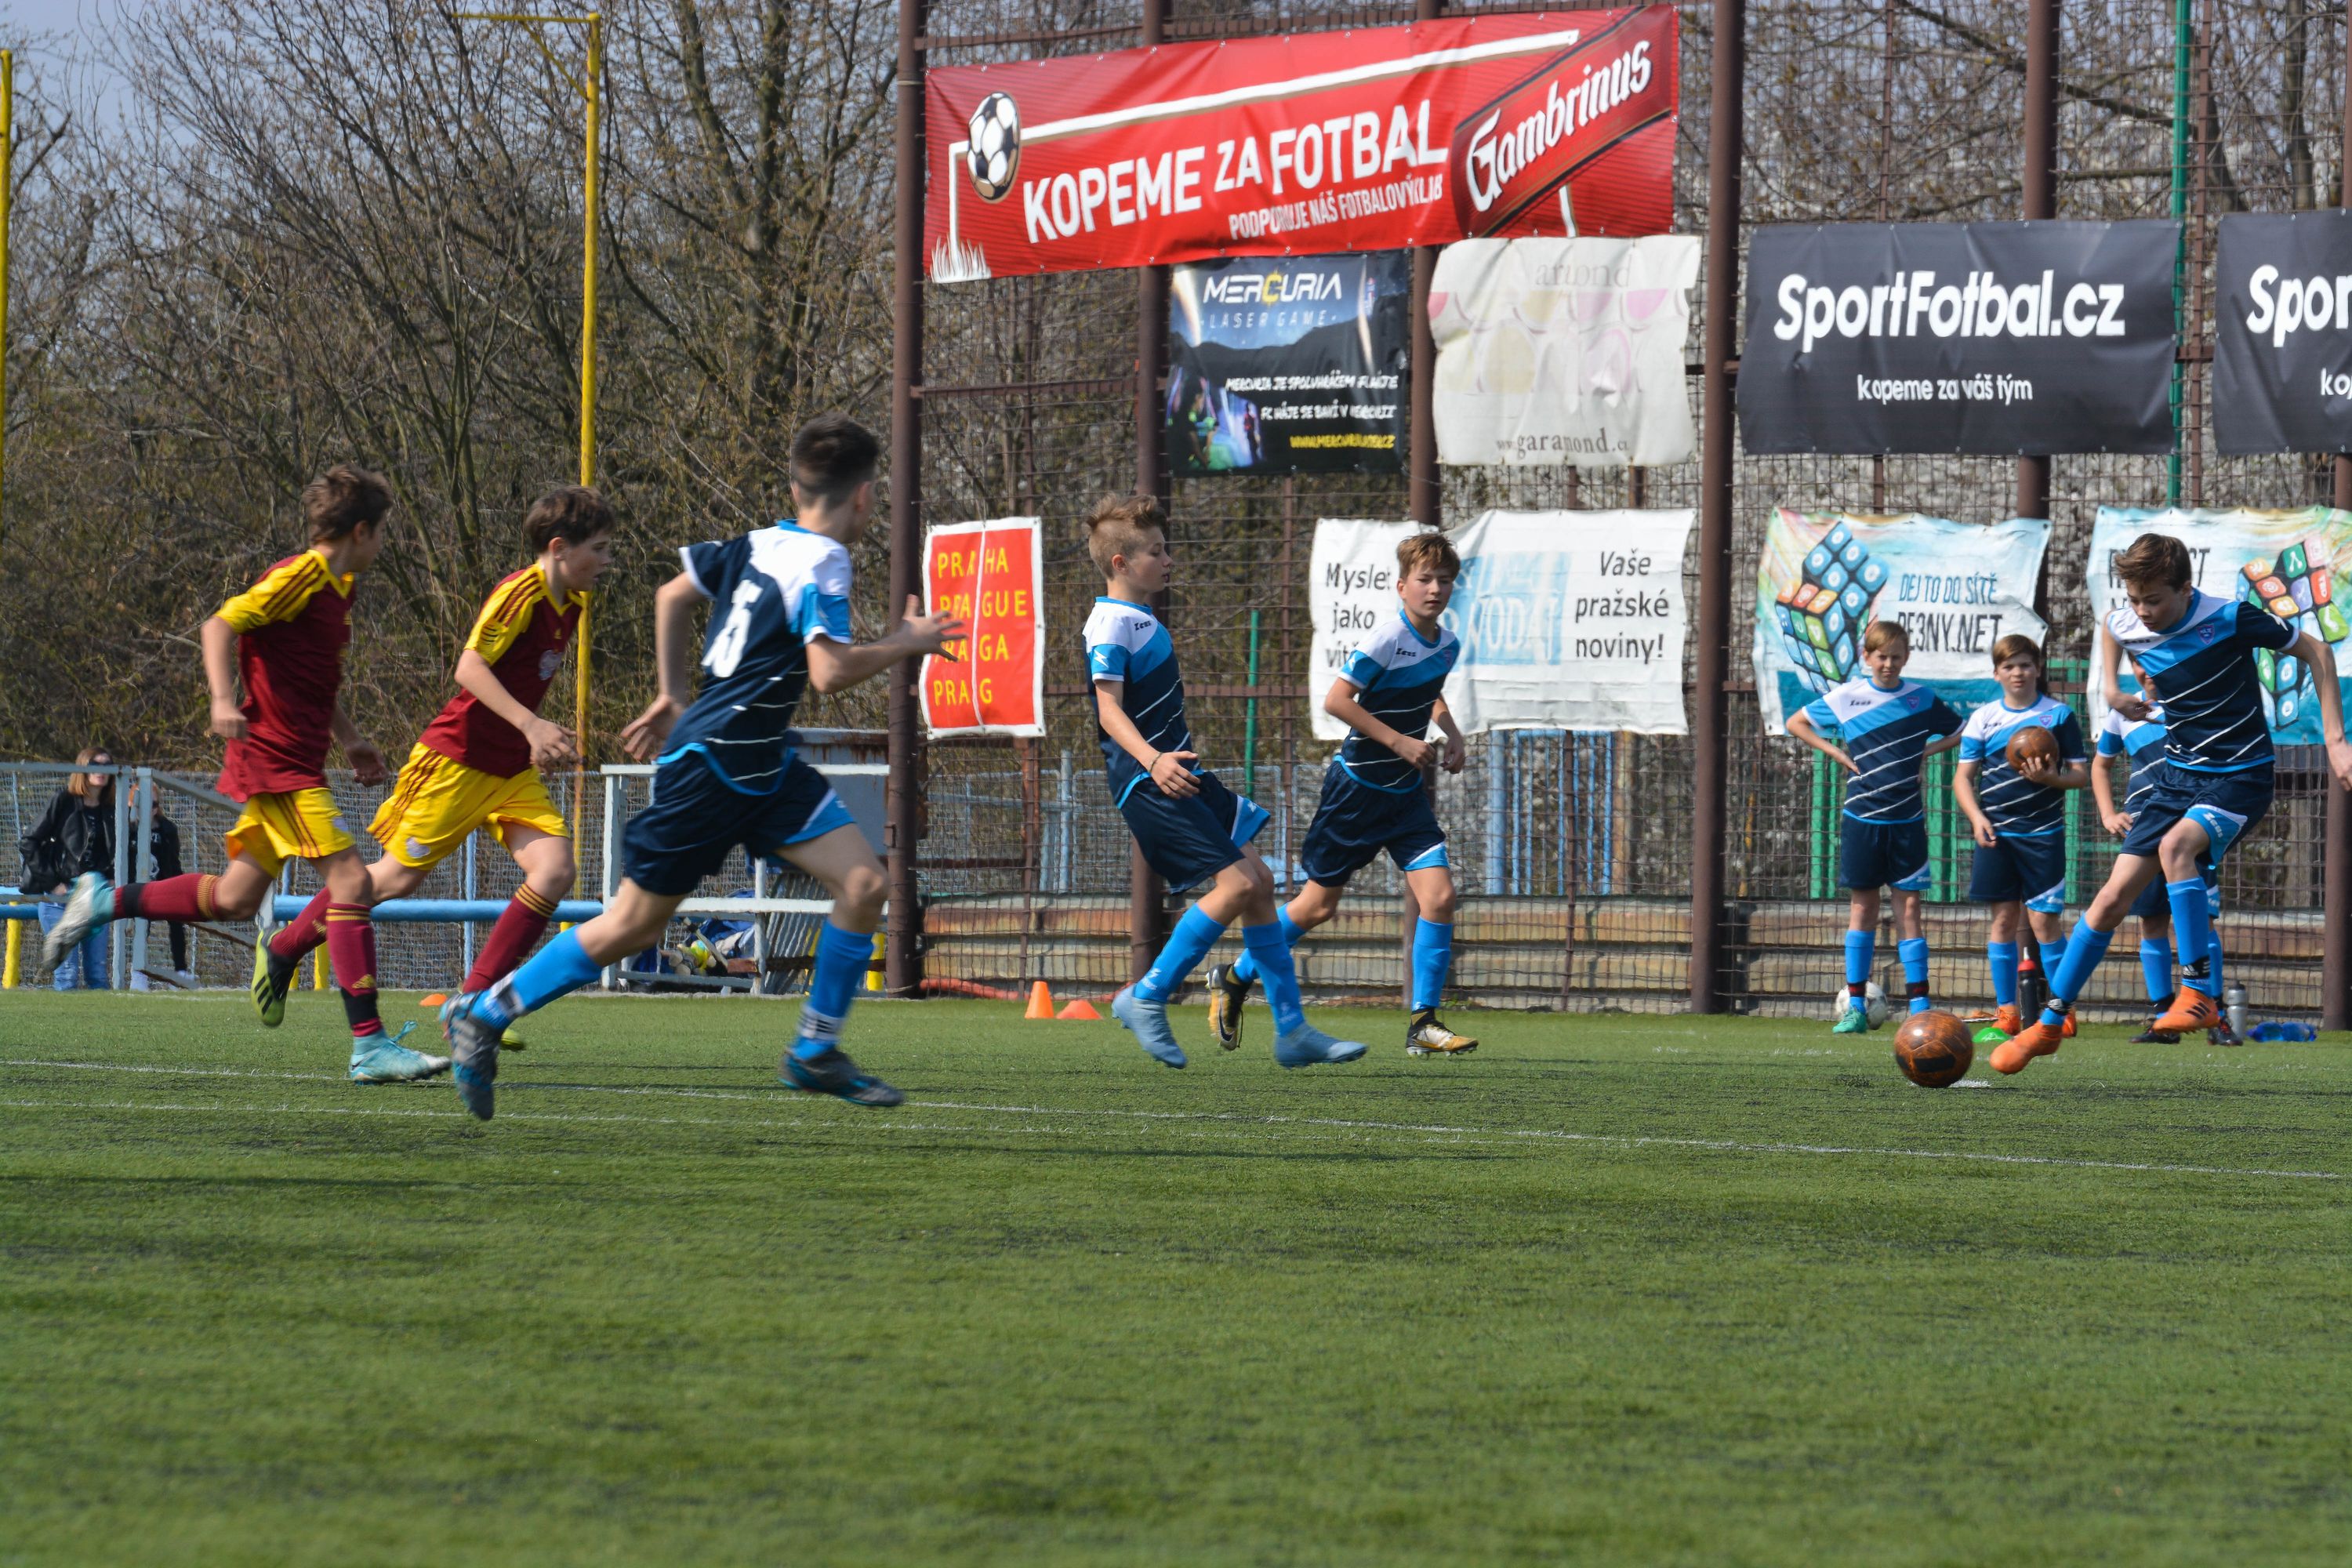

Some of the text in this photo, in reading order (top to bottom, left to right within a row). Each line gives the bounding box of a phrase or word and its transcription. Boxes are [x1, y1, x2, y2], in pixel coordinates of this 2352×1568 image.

[1466, 41, 1652, 212] Gambrinus
[1023, 146, 1206, 243] KOPEME
[1215, 136, 1264, 193] ZA
[1272, 99, 1448, 195] FOTBAL
[1309, 190, 1338, 226] NÁŠ
[1203, 272, 1342, 303] MERCURIA
[1210, 309, 1328, 328] LASER GAME
[1773, 270, 2126, 353] SportFotbal.cz
[1857, 373, 2033, 406] kopeme za váš tým
[938, 546, 1009, 579] PRAHA
[1600, 549, 1651, 576] Vaše
[1900, 572, 1997, 604] DEJ TO DO SÍTĚ
[1333, 602, 1376, 633] jako
[1576, 590, 1669, 622] pražské
[1576, 632, 1663, 665] noviny!
[934, 677, 993, 706] PRAG
